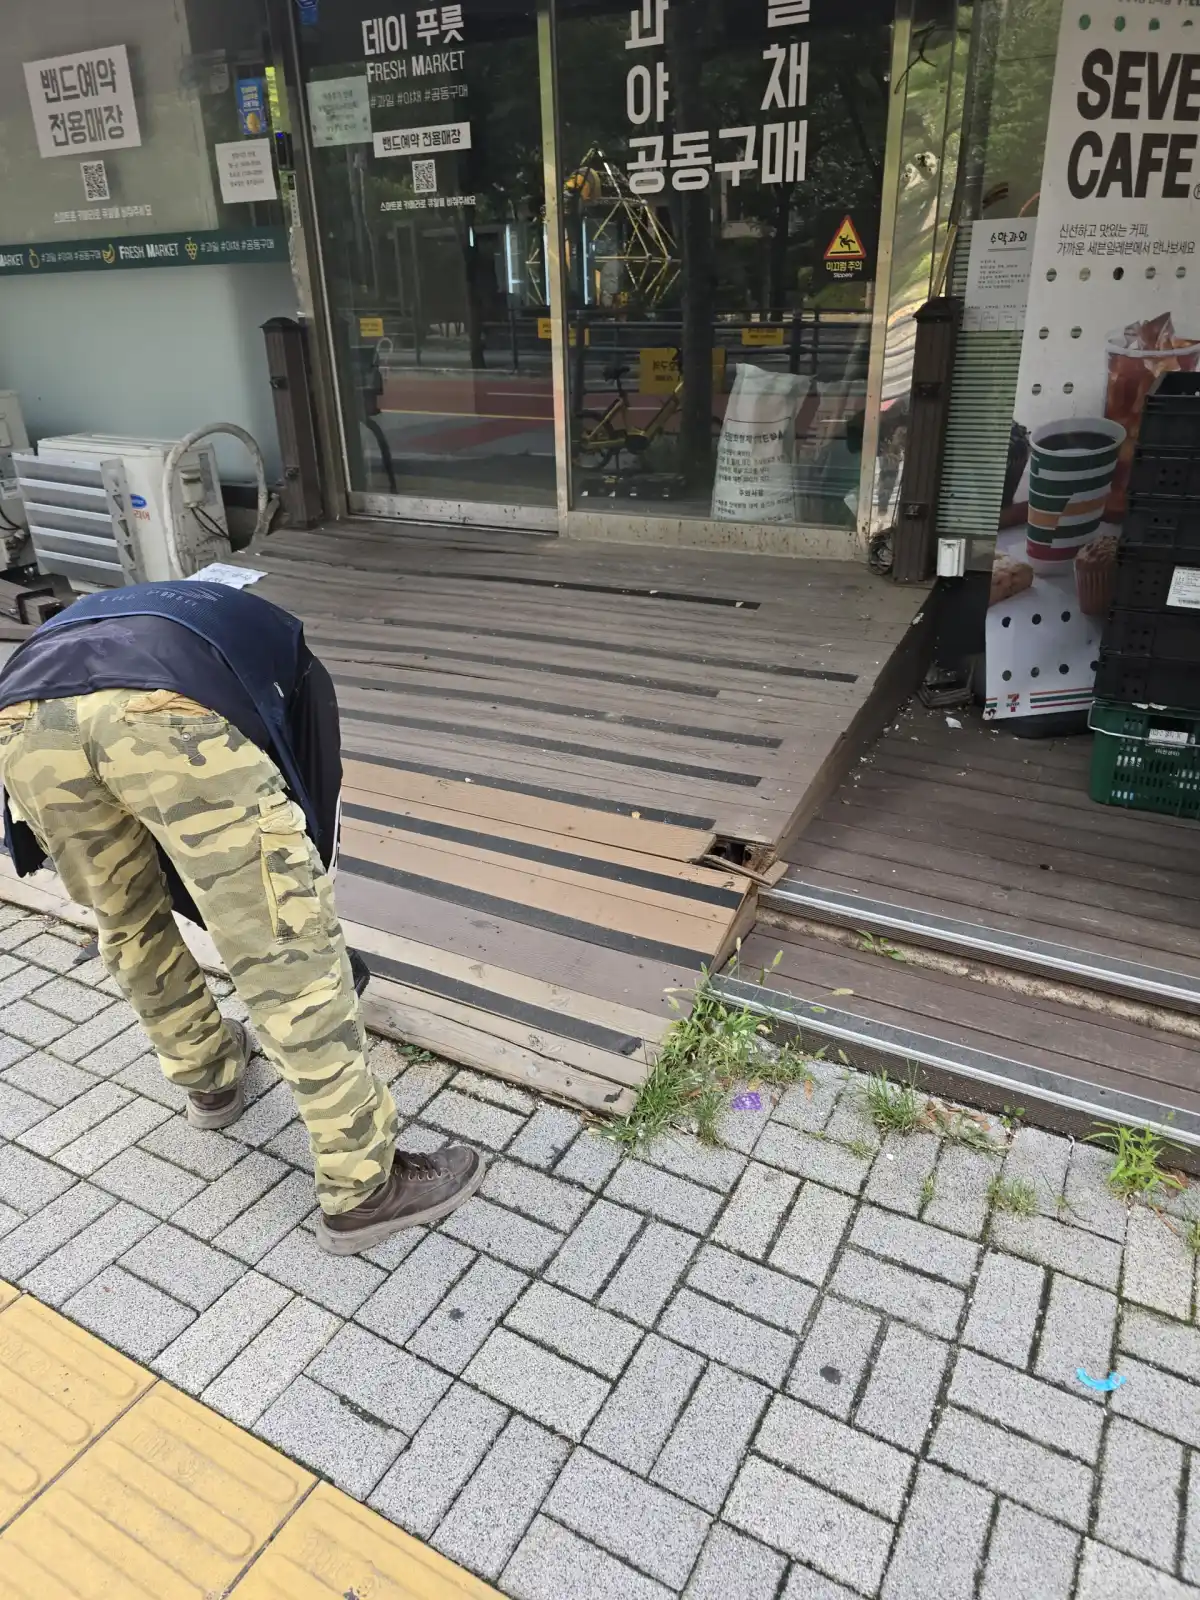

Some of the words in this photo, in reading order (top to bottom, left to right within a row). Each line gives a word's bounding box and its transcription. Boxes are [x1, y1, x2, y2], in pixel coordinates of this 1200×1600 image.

[361, 14, 408, 56] 데이
[416, 4, 465, 47] 푸릇
[366, 60, 407, 83] FRESH
[411, 50, 465, 77] MARKET
[40, 58, 117, 104] 밴드예약
[370, 94, 395, 108] #과일
[397, 90, 422, 105] #야채
[424, 84, 469, 102] #공동구매
[48, 105, 125, 147] 전용매장
[382, 133, 420, 152] 밴드예약
[422, 128, 461, 147] 전용매장
[626, 119, 808, 195] 공동구매
[1067, 130, 1198, 199] CAFE
[241, 239, 274, 251] #공동구매
[1060, 223, 1097, 239] 신선하고
[1099, 223, 1127, 238] 맛있는
[118, 245, 145, 259] FRESH
[146, 243, 179, 258] MARKET
[1056, 241, 1085, 257] 가까운
[1087, 241, 1151, 256] 세븐일레븐에서
[1152, 240, 1196, 255] 만나보세요
